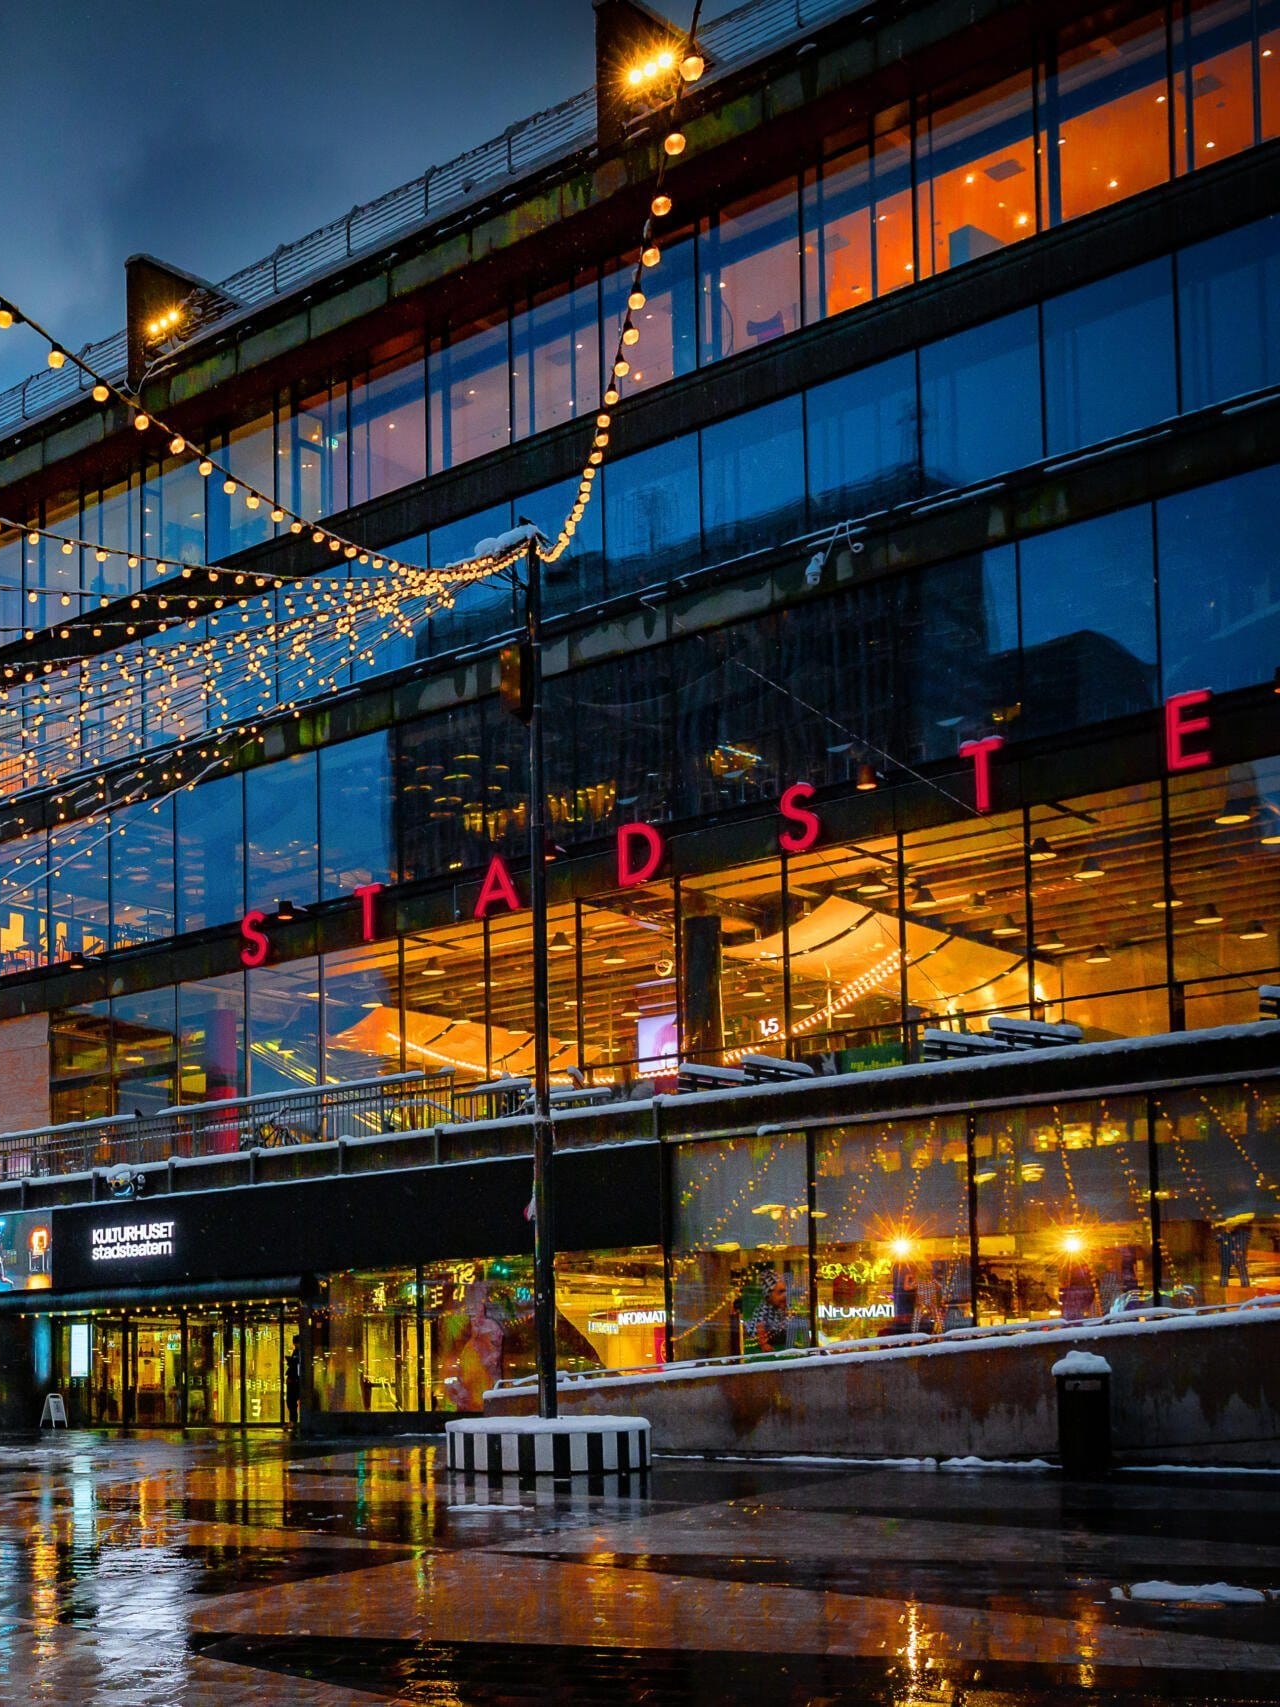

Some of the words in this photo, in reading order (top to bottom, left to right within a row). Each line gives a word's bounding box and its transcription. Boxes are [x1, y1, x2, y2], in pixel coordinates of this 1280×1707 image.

[92, 1221, 175, 1245] KULTURHUSET
[92, 1240, 172, 1261] stadsteatern
[818, 1303, 895, 1318] INFORMATI
